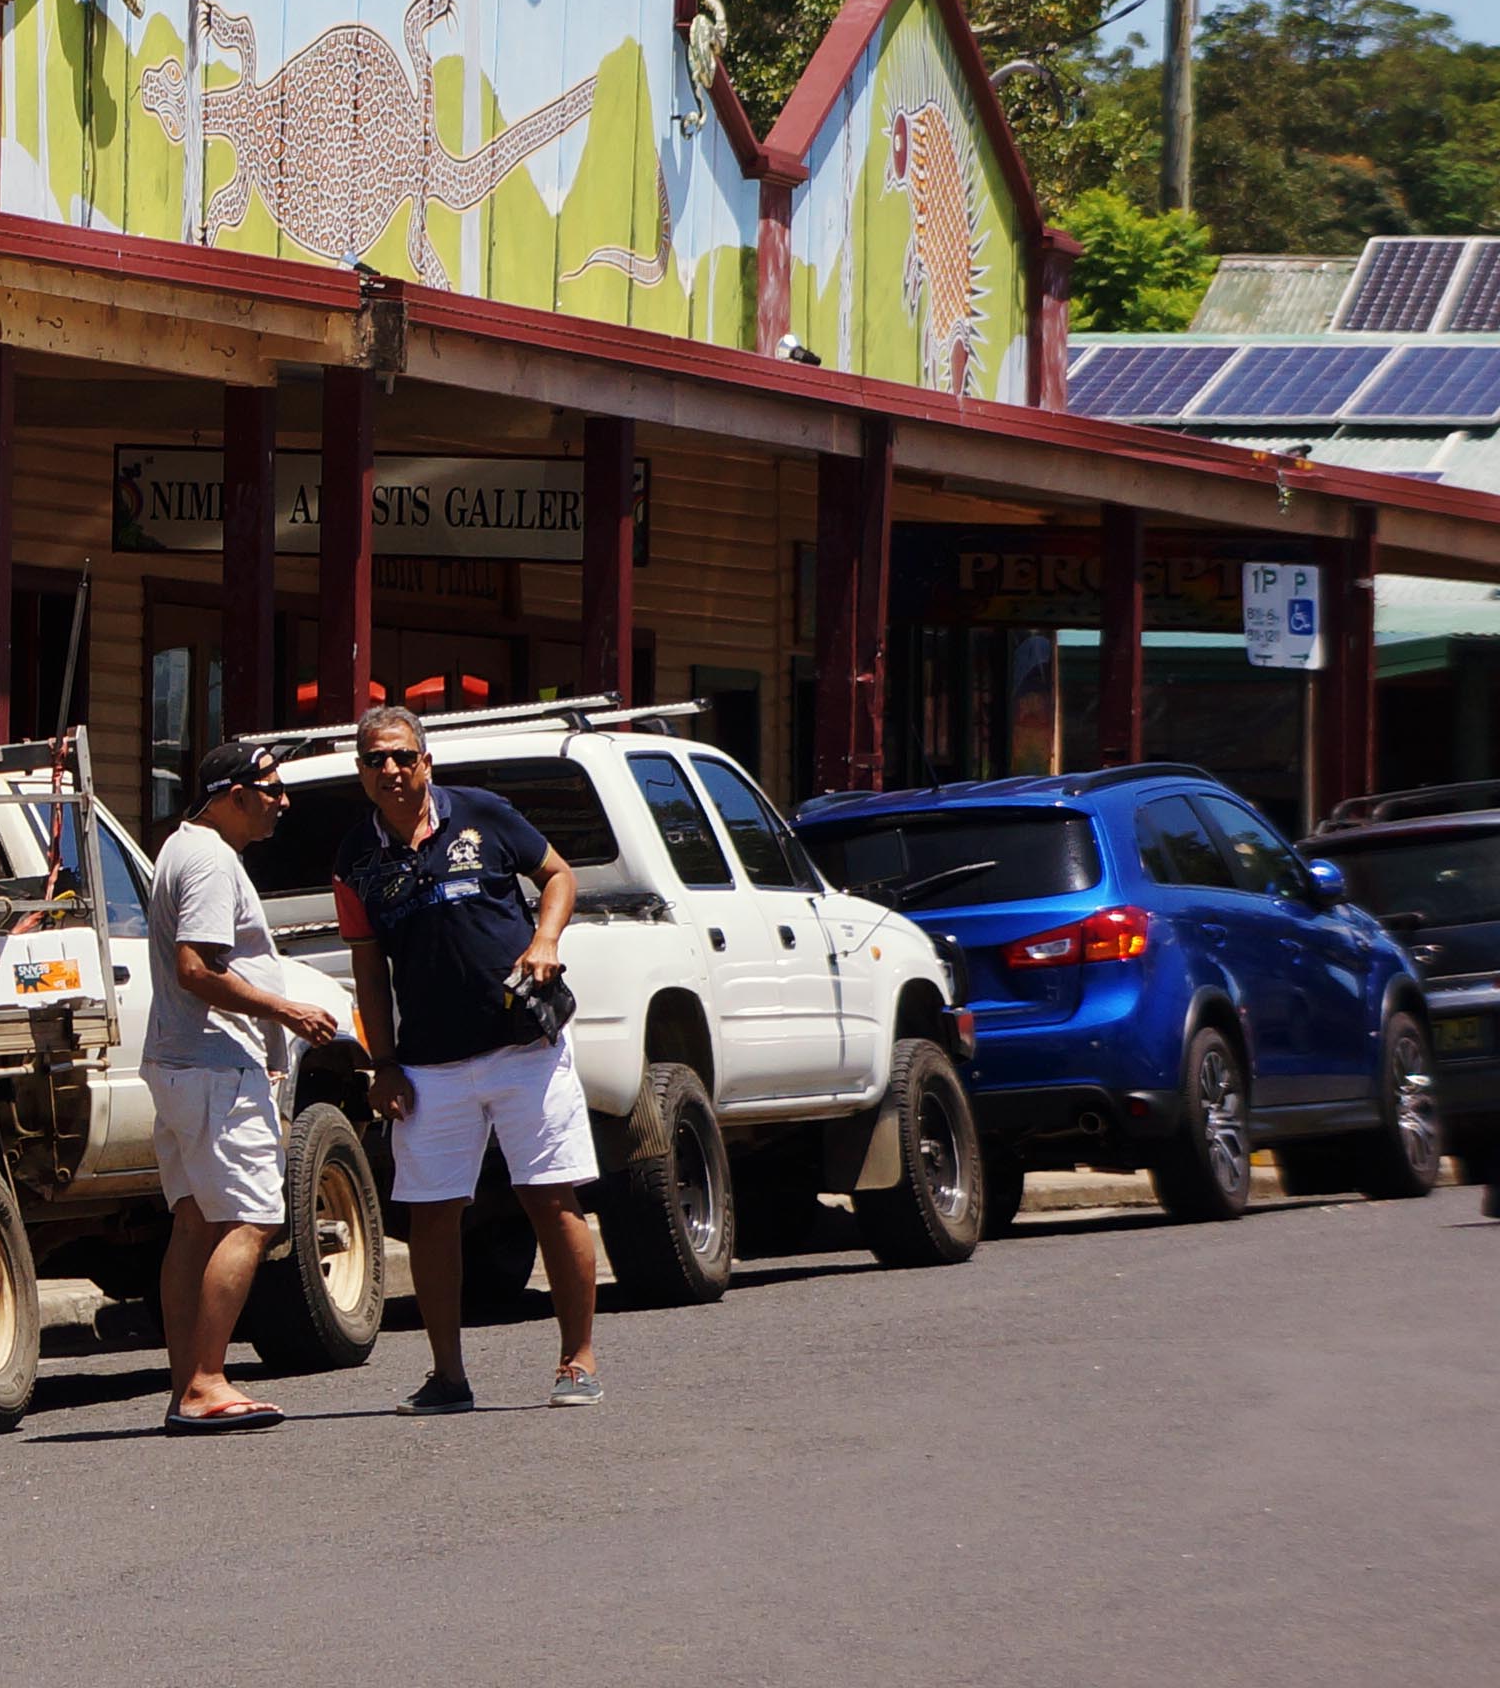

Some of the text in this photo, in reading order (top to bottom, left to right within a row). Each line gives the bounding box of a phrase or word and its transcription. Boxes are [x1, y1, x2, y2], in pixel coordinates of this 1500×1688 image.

[444, 485, 588, 532] GALLER
[1252, 569, 1307, 595] 1P P
